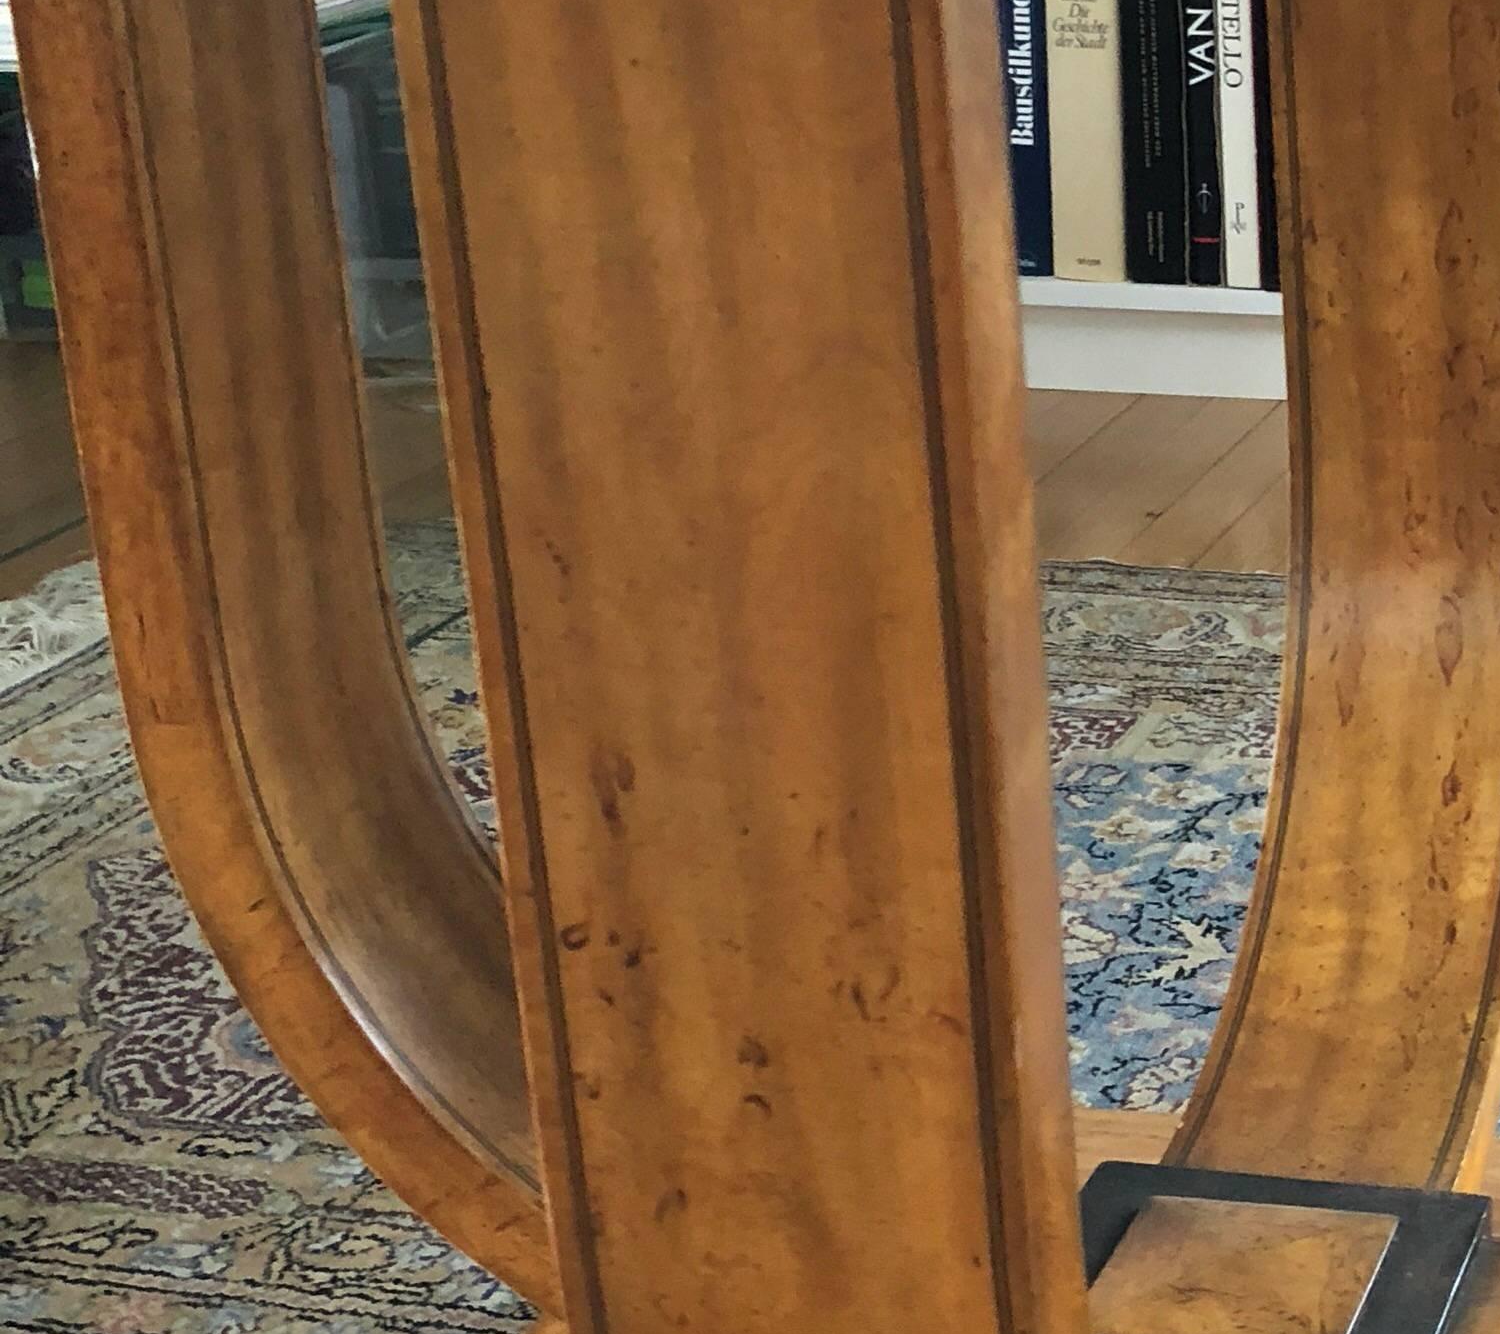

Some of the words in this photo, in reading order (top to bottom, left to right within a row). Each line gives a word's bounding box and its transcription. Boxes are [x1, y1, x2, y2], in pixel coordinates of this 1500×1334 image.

[1069, 3, 1090, 18] Die
[1052, 17, 1109, 34] Geschichte
[1056, 33, 1075, 47] der
[1075, 33, 1107, 49] Stadt
[1187, 9, 1214, 87] VAN
